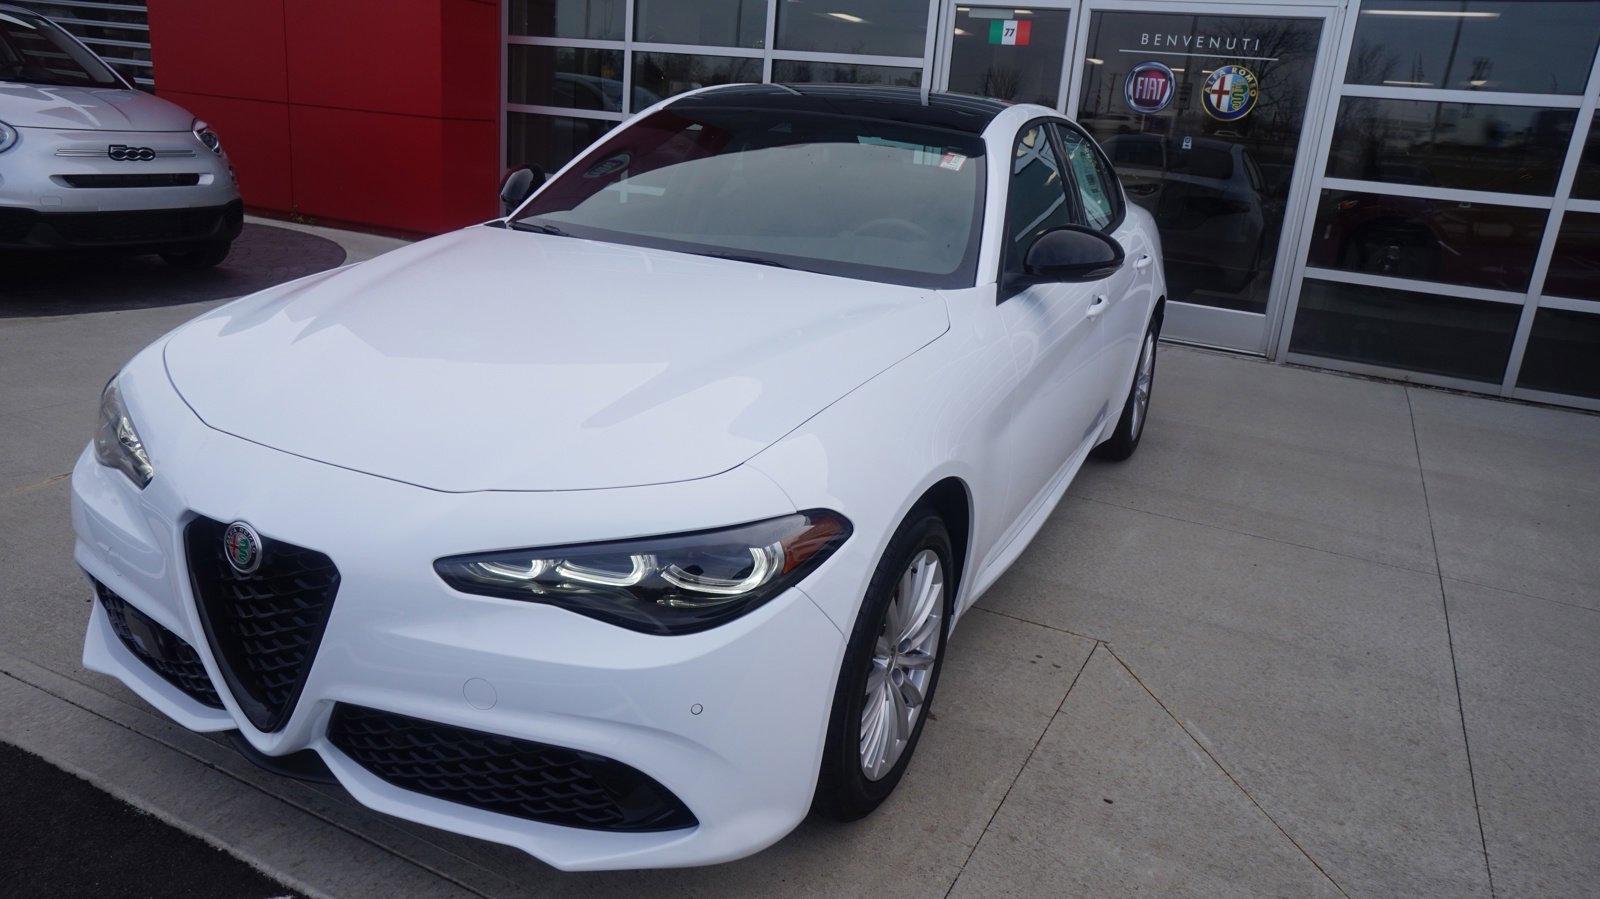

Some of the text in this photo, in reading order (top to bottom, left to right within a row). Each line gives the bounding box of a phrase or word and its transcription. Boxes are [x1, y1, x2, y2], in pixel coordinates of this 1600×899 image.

[1004, 28, 1015, 37] 77
[1141, 33, 1260, 51] BENVENUTI
[1135, 76, 1166, 101] FIAT
[1204, 67, 1257, 97] ALFA ROMEO
[108, 144, 156, 161] 500
